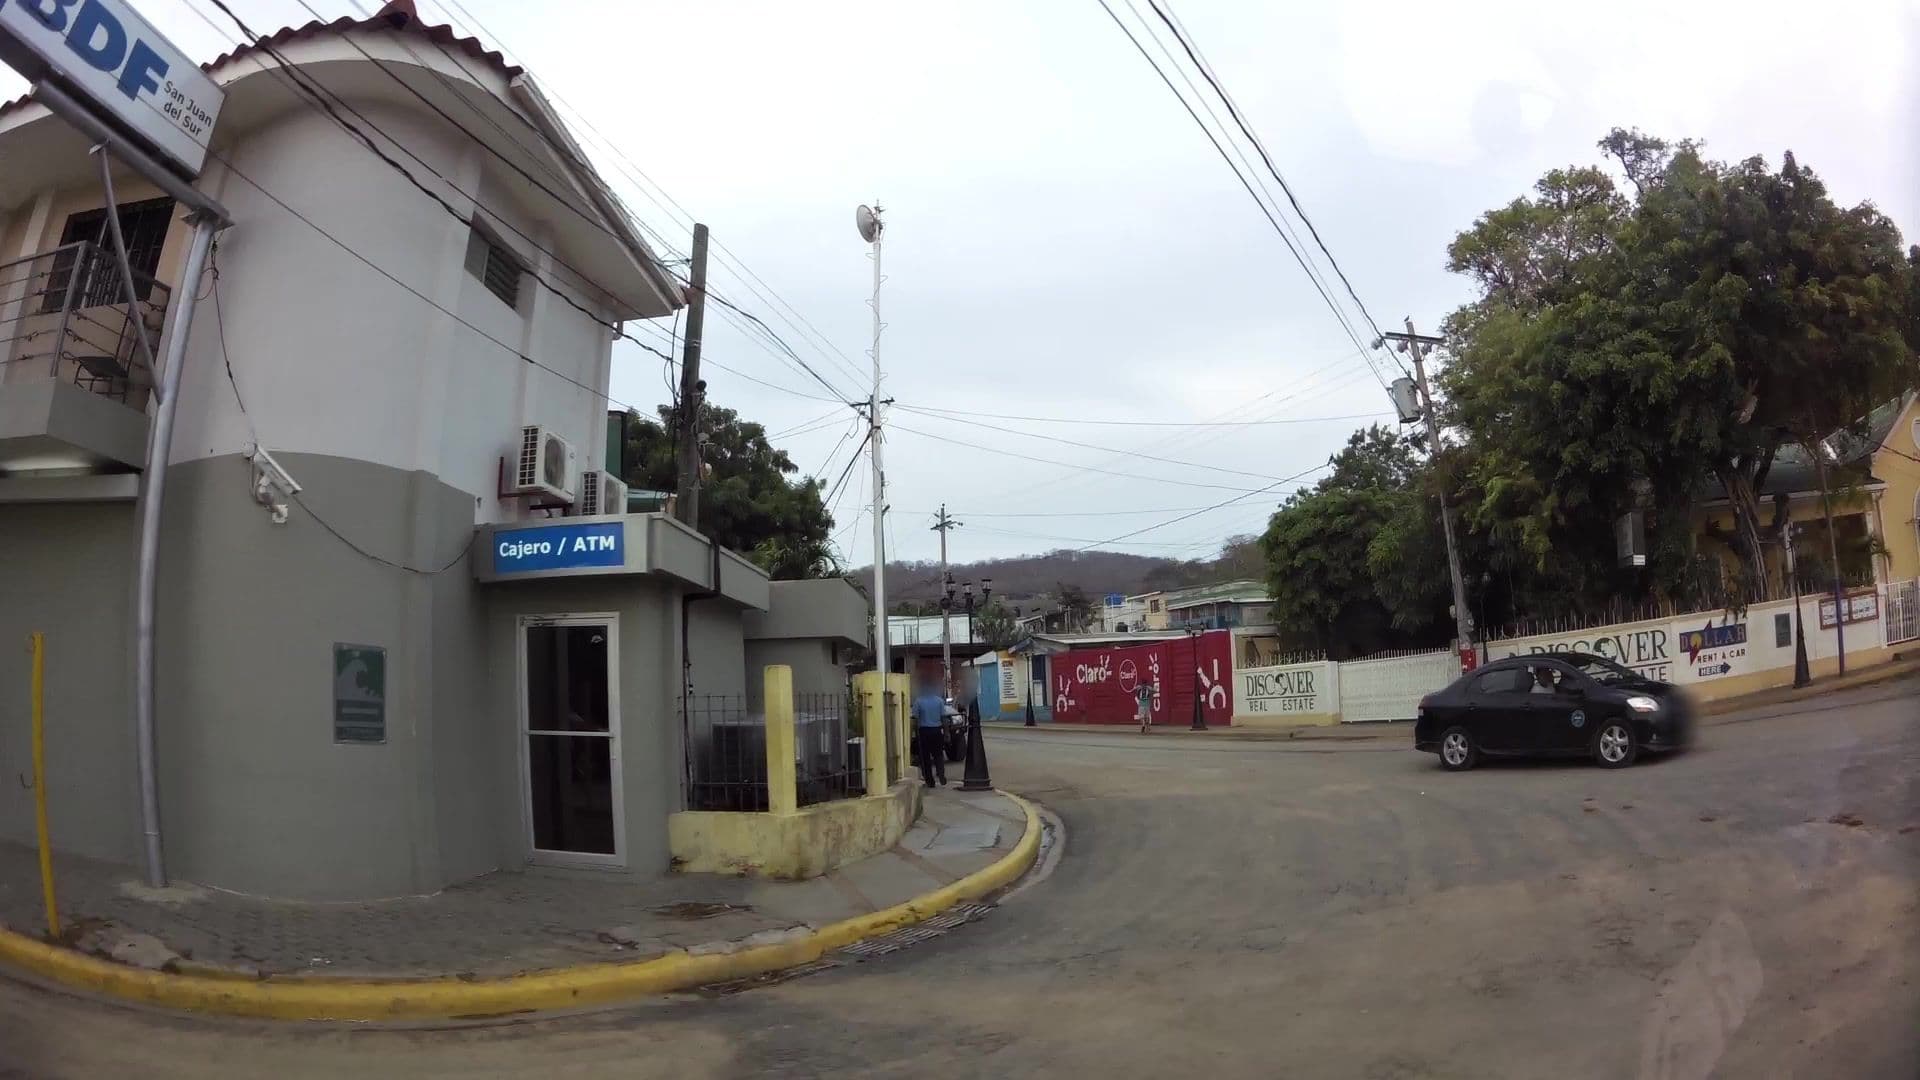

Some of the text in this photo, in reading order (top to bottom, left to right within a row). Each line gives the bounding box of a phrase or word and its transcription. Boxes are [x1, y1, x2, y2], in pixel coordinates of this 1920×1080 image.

[163, 80, 212, 127] San Juan
[163, 102, 202, 136] del Sur
[500, 535, 615, 559] Cajero / ATM
[1697, 648, 1746, 664] RENT A CAR
[1076, 660, 1108, 684] Claro
[1700, 664, 1722, 676] HERE
[1152, 657, 1160, 711] Claro
[1245, 671, 1315, 697] DISCOVER
[1249, 698, 1315, 712] REAL ESTATE
